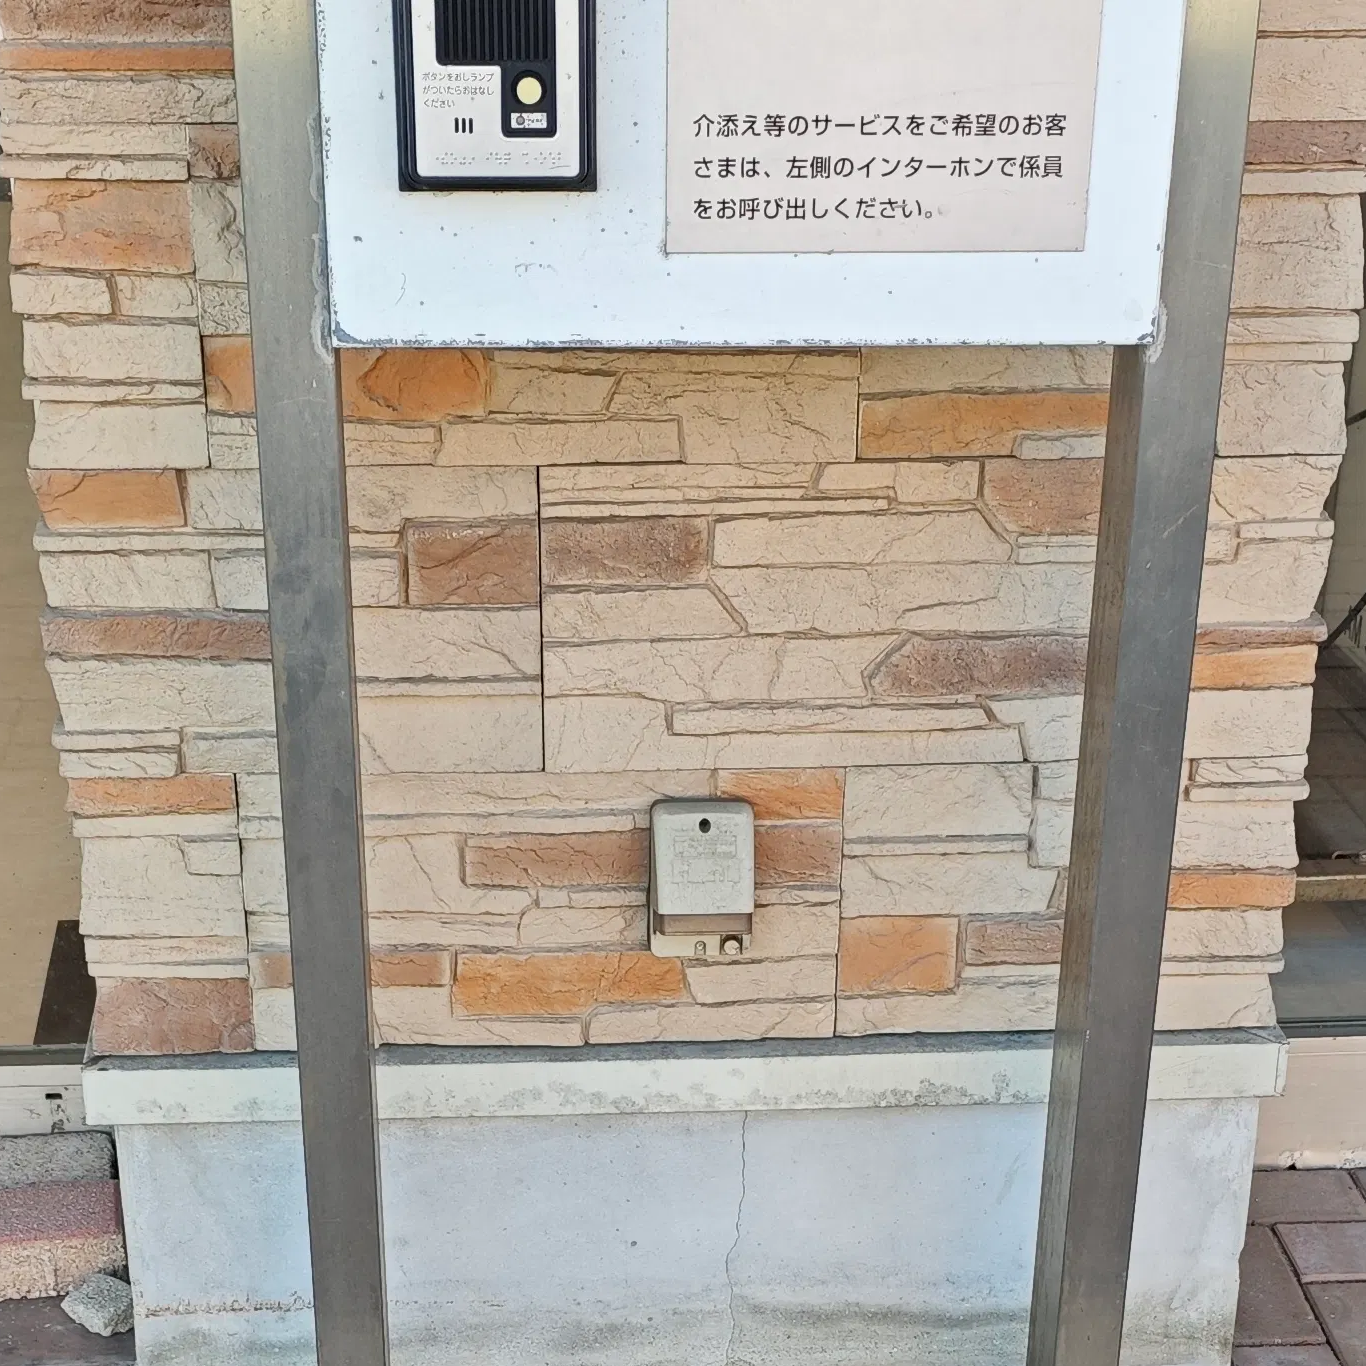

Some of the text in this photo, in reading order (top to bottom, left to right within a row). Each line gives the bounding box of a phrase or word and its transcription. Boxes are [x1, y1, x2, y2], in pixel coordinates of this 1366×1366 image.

[422, 72, 494, 82] ボタンをおしランプ
[423, 85, 494, 95] がついたらおはなし
[424, 99, 455, 108] ください
[693, 113, 1067, 138] 介添え等のサービスをご希望のお客
[693, 155, 1063, 179] さまは、左側のインターホンで係員
[693, 197, 934, 221] をお呼び出しください。
